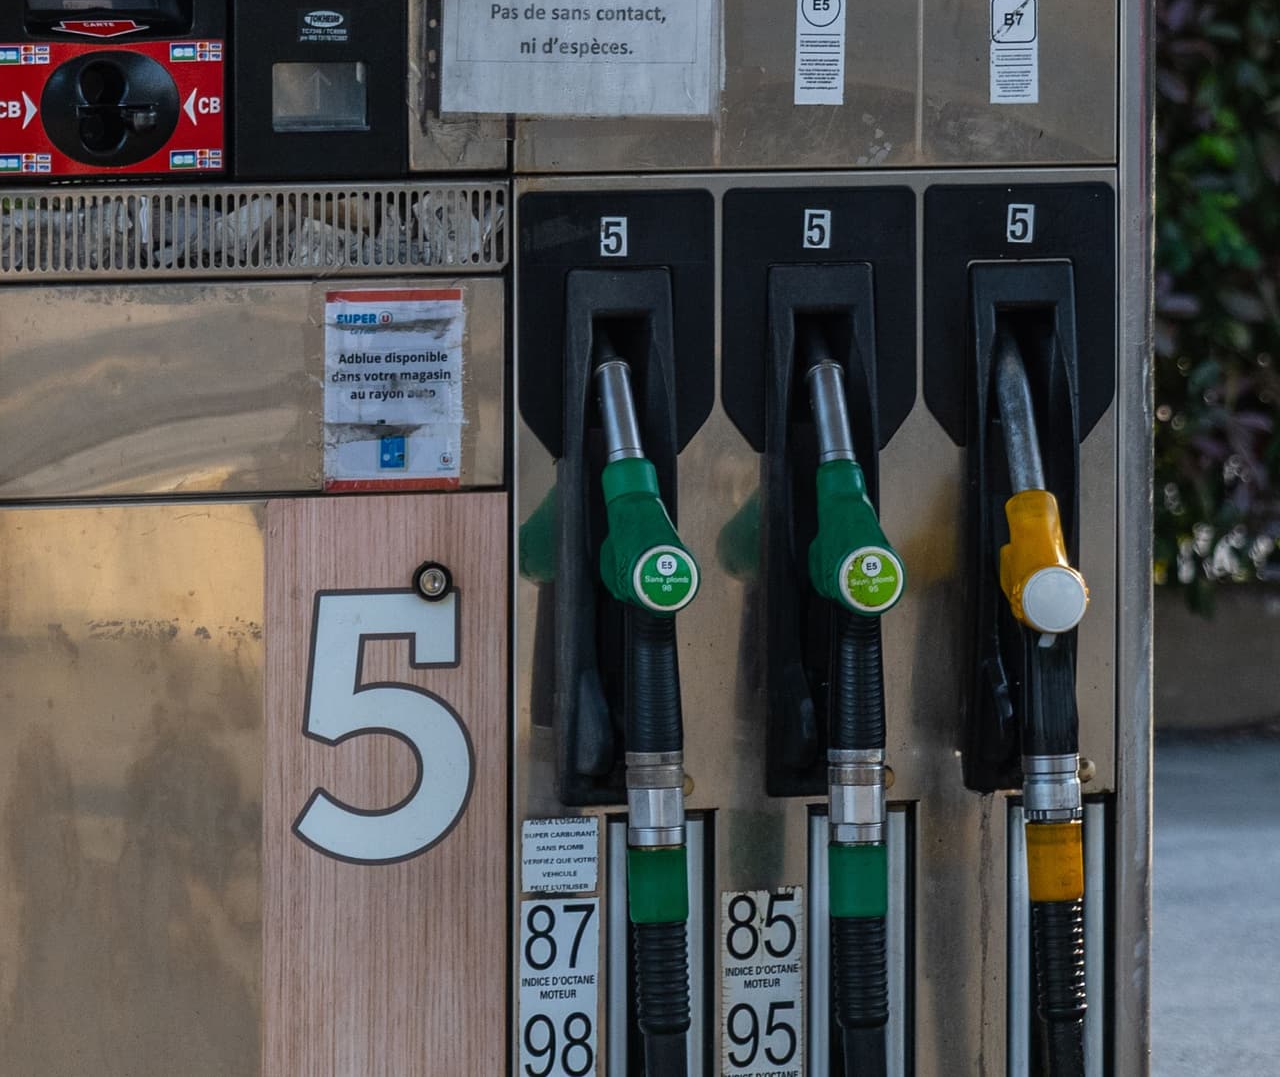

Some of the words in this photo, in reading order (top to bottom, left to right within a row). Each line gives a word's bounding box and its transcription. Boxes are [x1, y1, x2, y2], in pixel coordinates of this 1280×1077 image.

[490, 4, 519, 20] Pas
[524, 3, 546, 21] de
[551, 7, 591, 21] sans
[596, 5, 667, 24] contact,
[1004, 12, 1024, 26] B7
[520, 39, 537, 55] ni
[198, 97, 221, 114] CB
[806, 212, 827, 247] 5
[1010, 207, 1031, 240] 5
[603, 220, 625, 254] 5
[337, 314, 377, 324] SUPER
[381, 314, 390, 323] U
[338, 352, 382, 364] Adblue
[384, 351, 448, 365] disponible
[332, 371, 361, 383] dans
[364, 371, 397, 382] votre
[400, 369, 451, 383] magasin
[350, 390, 366, 400] au
[369, 389, 404, 402] rayon
[661, 561, 673, 569] E5
[866, 562, 878, 570] E5
[645, 575, 664, 583] Sans
[666, 576, 689, 584] plomb
[872, 576, 895, 585] plomb
[662, 584, 673, 592] 98
[291, 586, 476, 866] 5
[550, 830, 596, 838] CARBURANT
[573, 856, 597, 864] VOTRE
[542, 870, 578, 878] VEHICULE
[551, 883, 589, 891] L'UTILISER
[726, 894, 797, 960] 85
[524, 903, 596, 970] 87
[725, 966, 754, 977] INDICE
[756, 963, 799, 975] D'OCTANE
[521, 976, 550, 987] INDICE
[552, 975, 595, 986] D'OCTANE
[743, 978, 781, 989] MOTEUR
[539, 989, 577, 1000] MOTEUR
[727, 1000, 797, 1068] 95
[524, 1011, 594, 1077] 98
